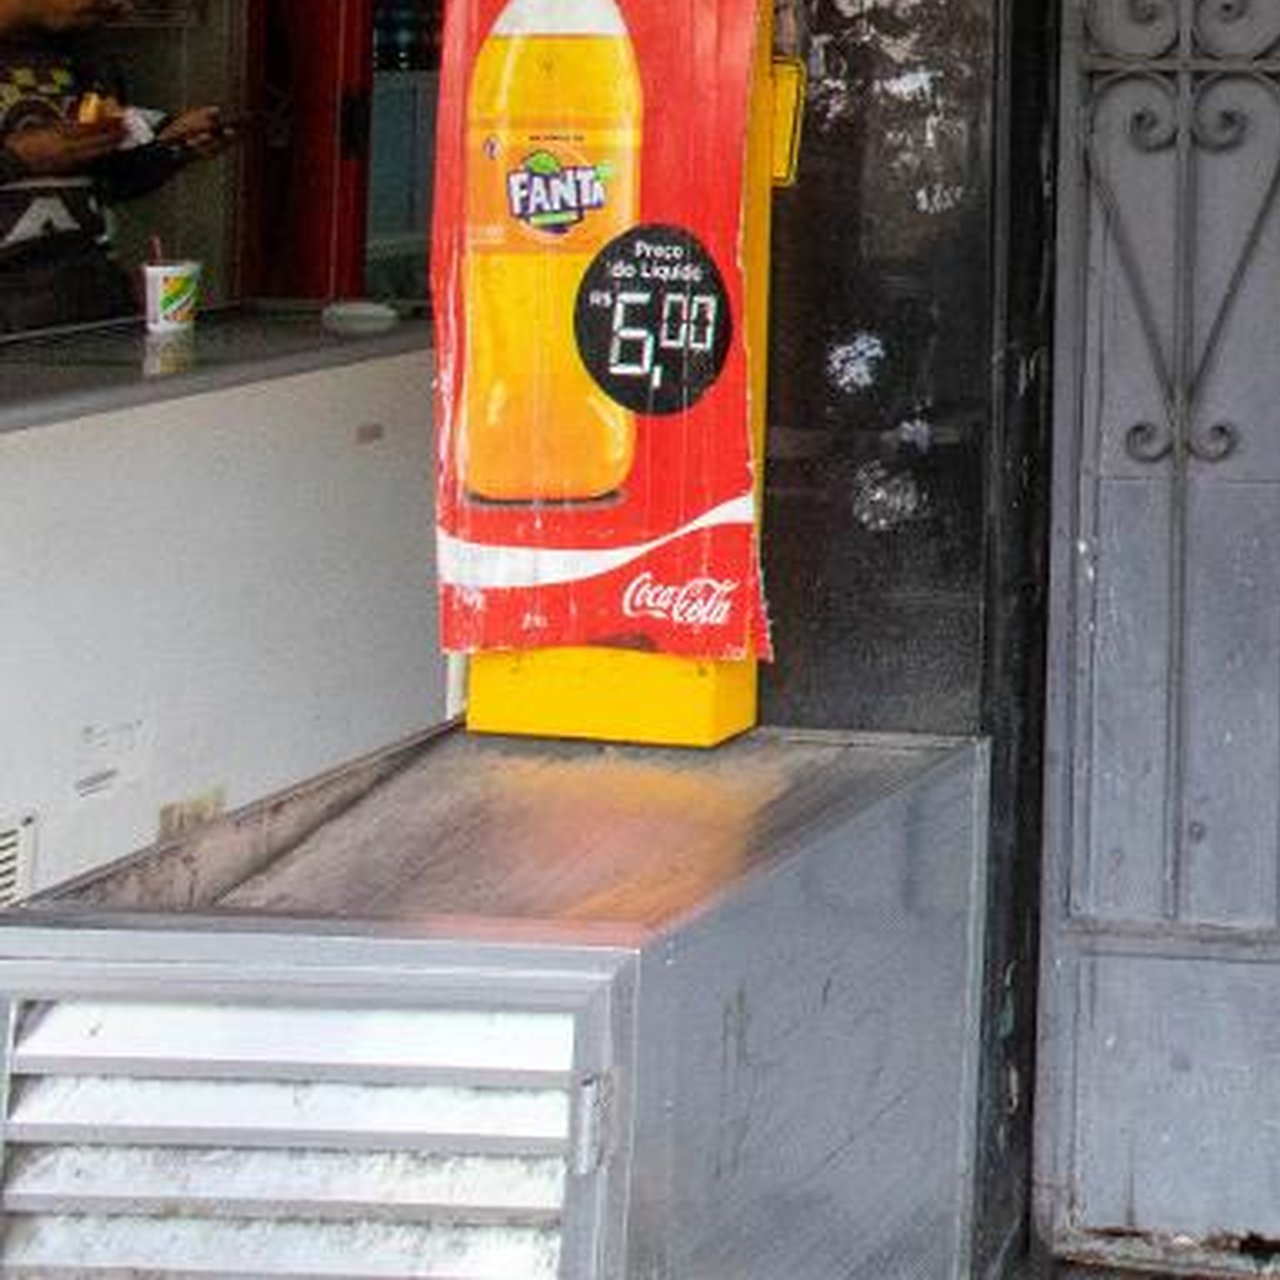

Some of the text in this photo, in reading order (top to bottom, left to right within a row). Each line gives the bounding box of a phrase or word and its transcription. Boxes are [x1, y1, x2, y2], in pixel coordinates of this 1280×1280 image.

[508, 169, 606, 215] FANTA
[611, 259, 637, 278] do
[634, 239, 684, 260] Preço
[589, 290, 717, 389] R$ 6,00
[622, 571, 738, 626] Coca-Cola
